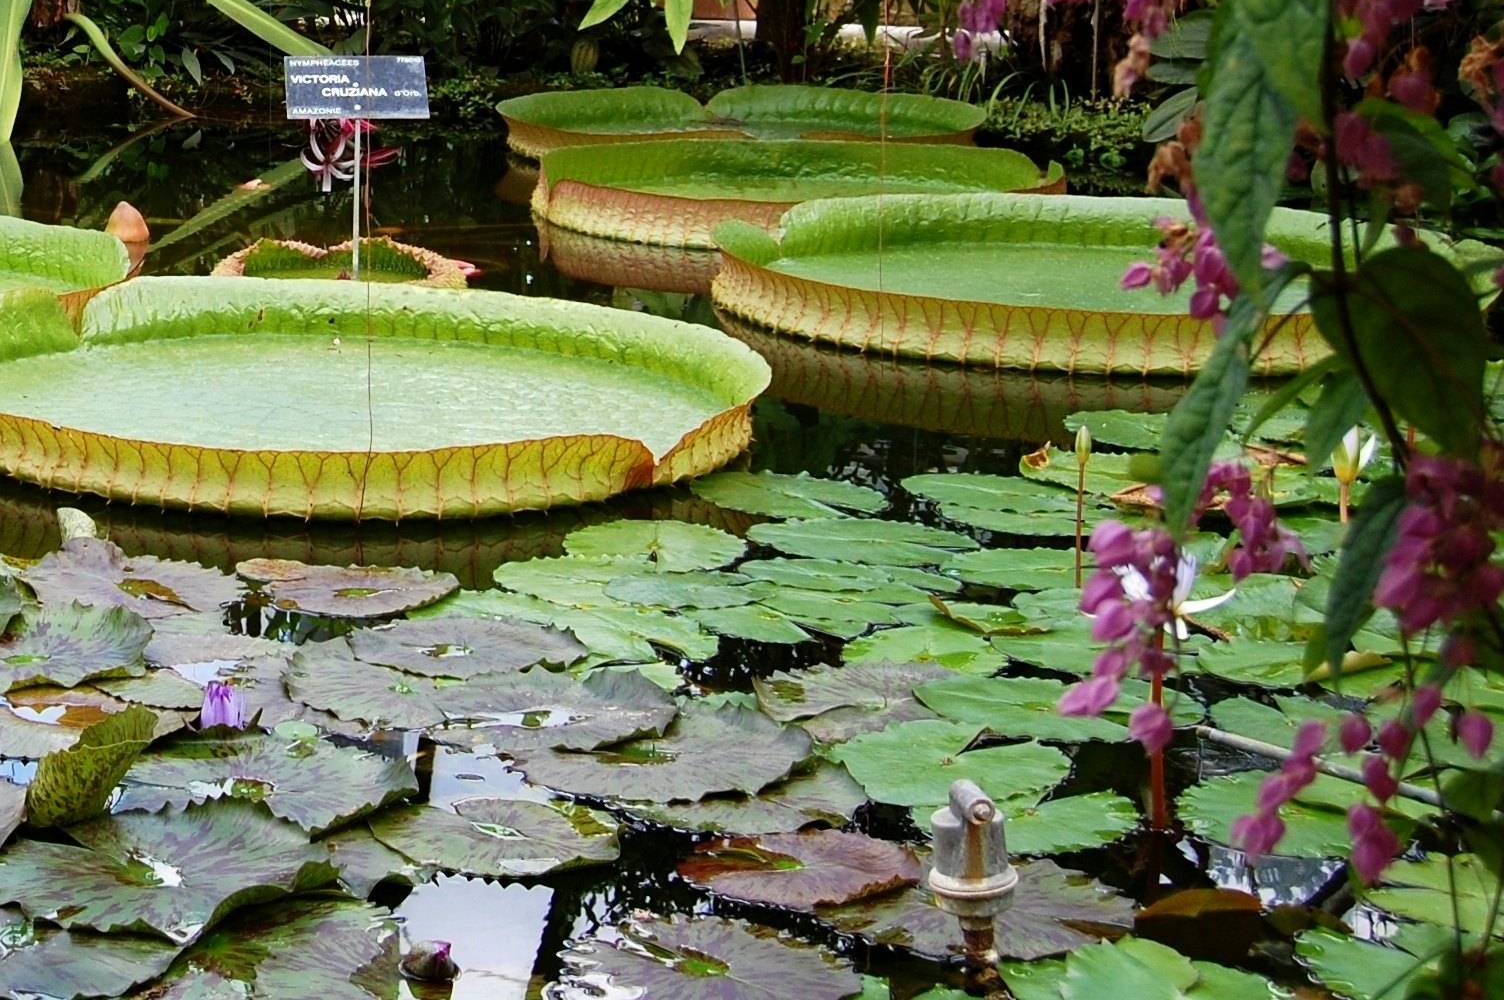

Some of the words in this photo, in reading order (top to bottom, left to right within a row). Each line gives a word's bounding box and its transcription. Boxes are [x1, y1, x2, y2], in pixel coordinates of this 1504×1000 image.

[290, 74, 351, 84] VICTORIA
[321, 87, 388, 97] CRUZIANA
[292, 107, 342, 115] AMAZONIE
